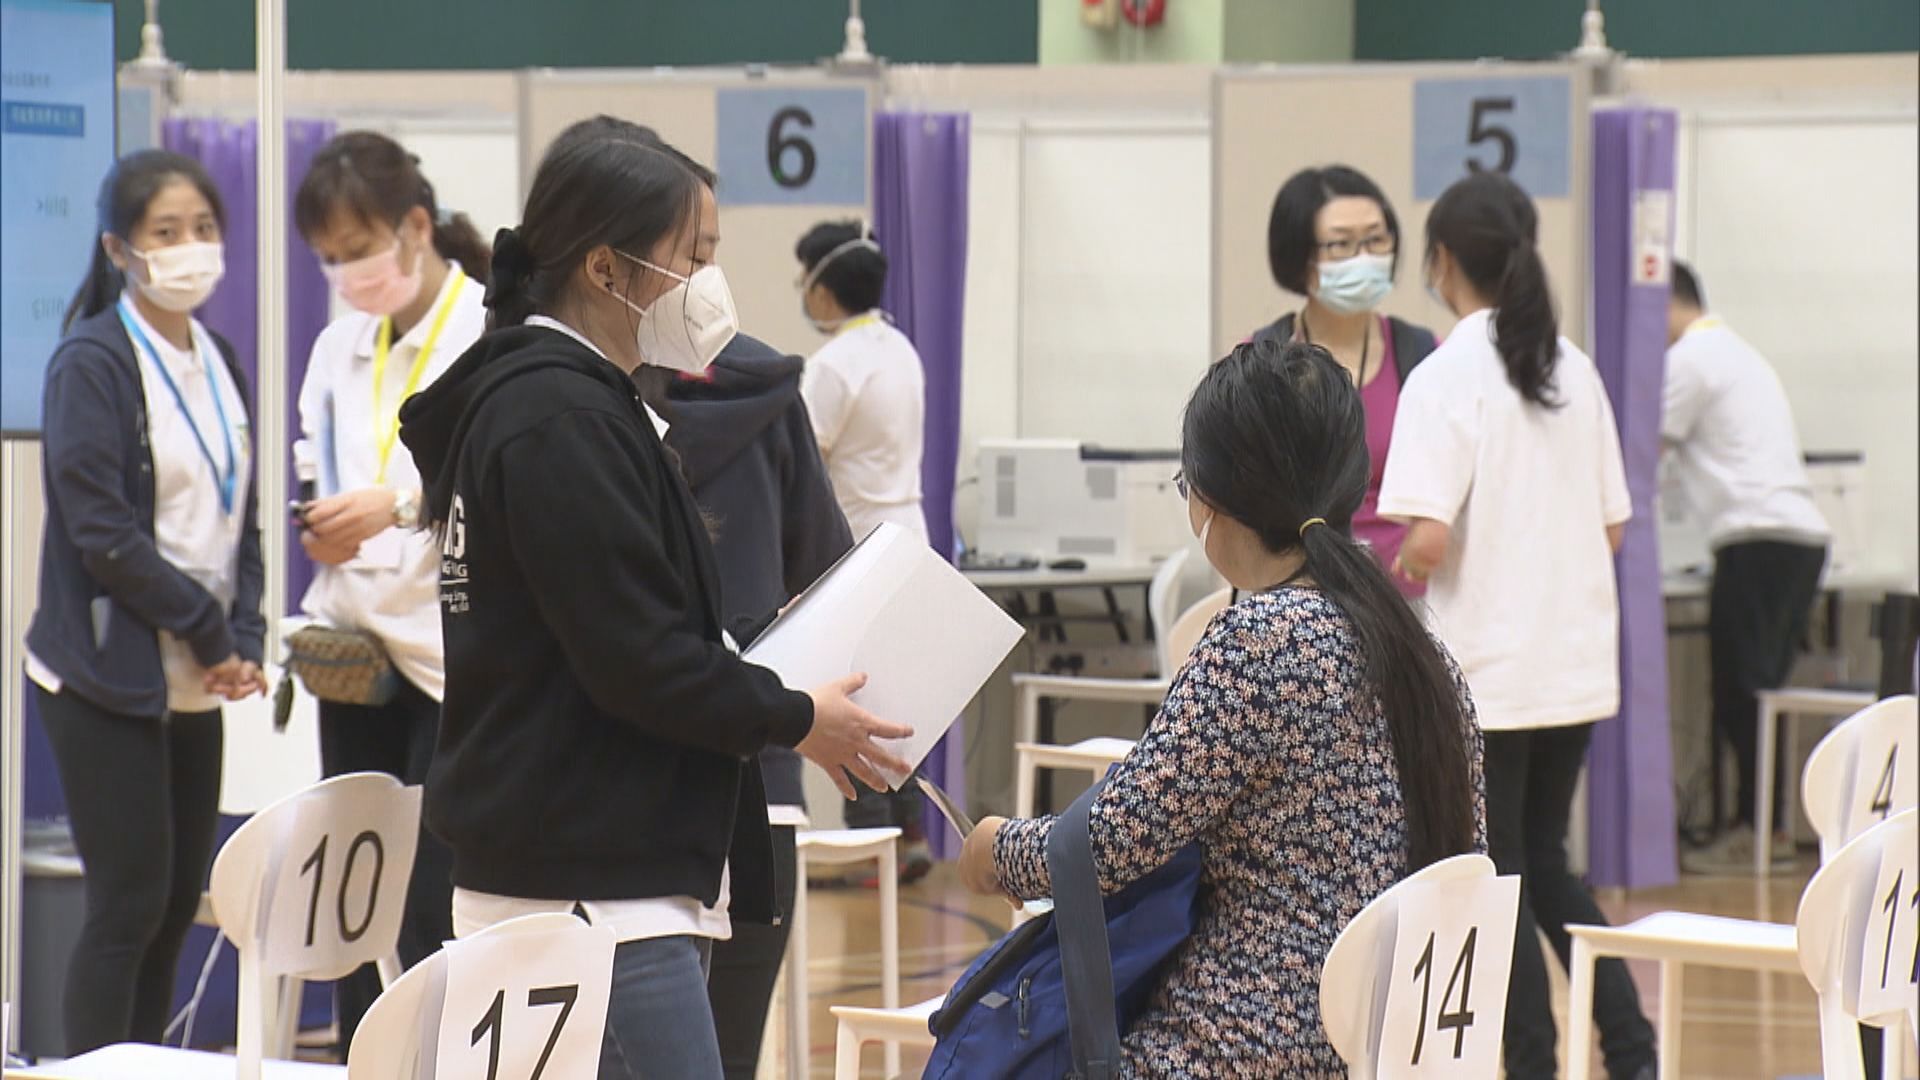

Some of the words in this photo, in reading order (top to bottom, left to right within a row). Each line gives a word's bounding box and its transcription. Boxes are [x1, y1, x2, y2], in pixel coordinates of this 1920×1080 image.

[767, 106, 816, 188] 6
[1465, 97, 1517, 174] 5
[1871, 743, 1898, 820] 4
[301, 830, 384, 947] 10
[471, 984, 579, 1080] 17
[1411, 926, 1478, 1065] 14
